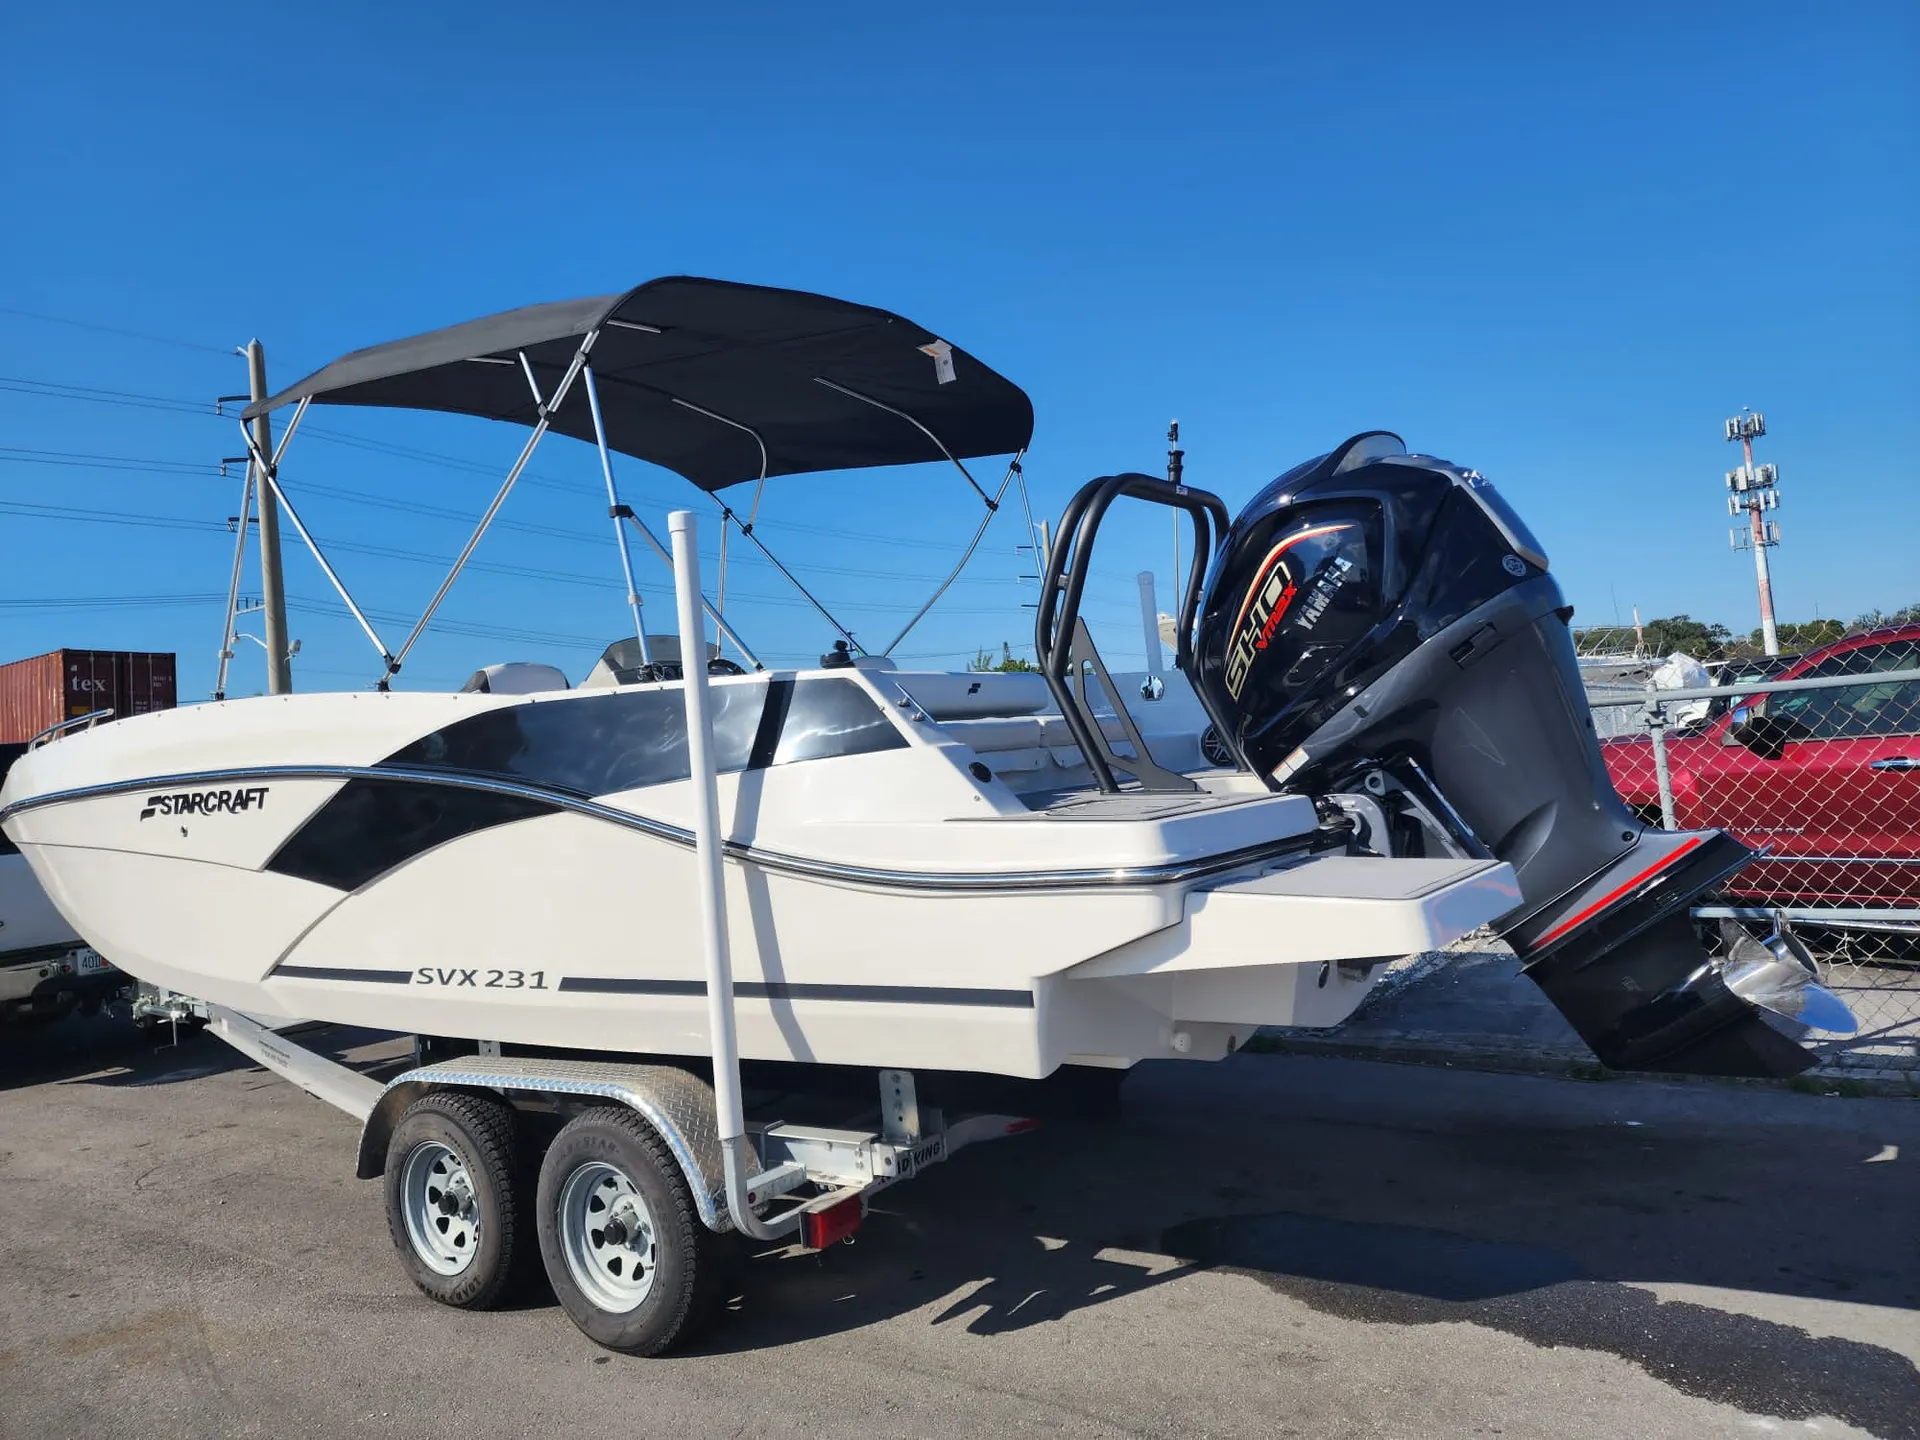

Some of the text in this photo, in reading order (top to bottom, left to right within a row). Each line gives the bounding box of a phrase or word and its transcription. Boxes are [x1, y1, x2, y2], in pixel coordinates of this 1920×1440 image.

[1295, 556, 1353, 630] YAMAHA
[1225, 561, 1293, 703] SHO
[71, 675, 106, 691] tex
[160, 787, 269, 816] STARCRAFT
[416, 967, 548, 989] SVX 231
[913, 1141, 940, 1168] KING
